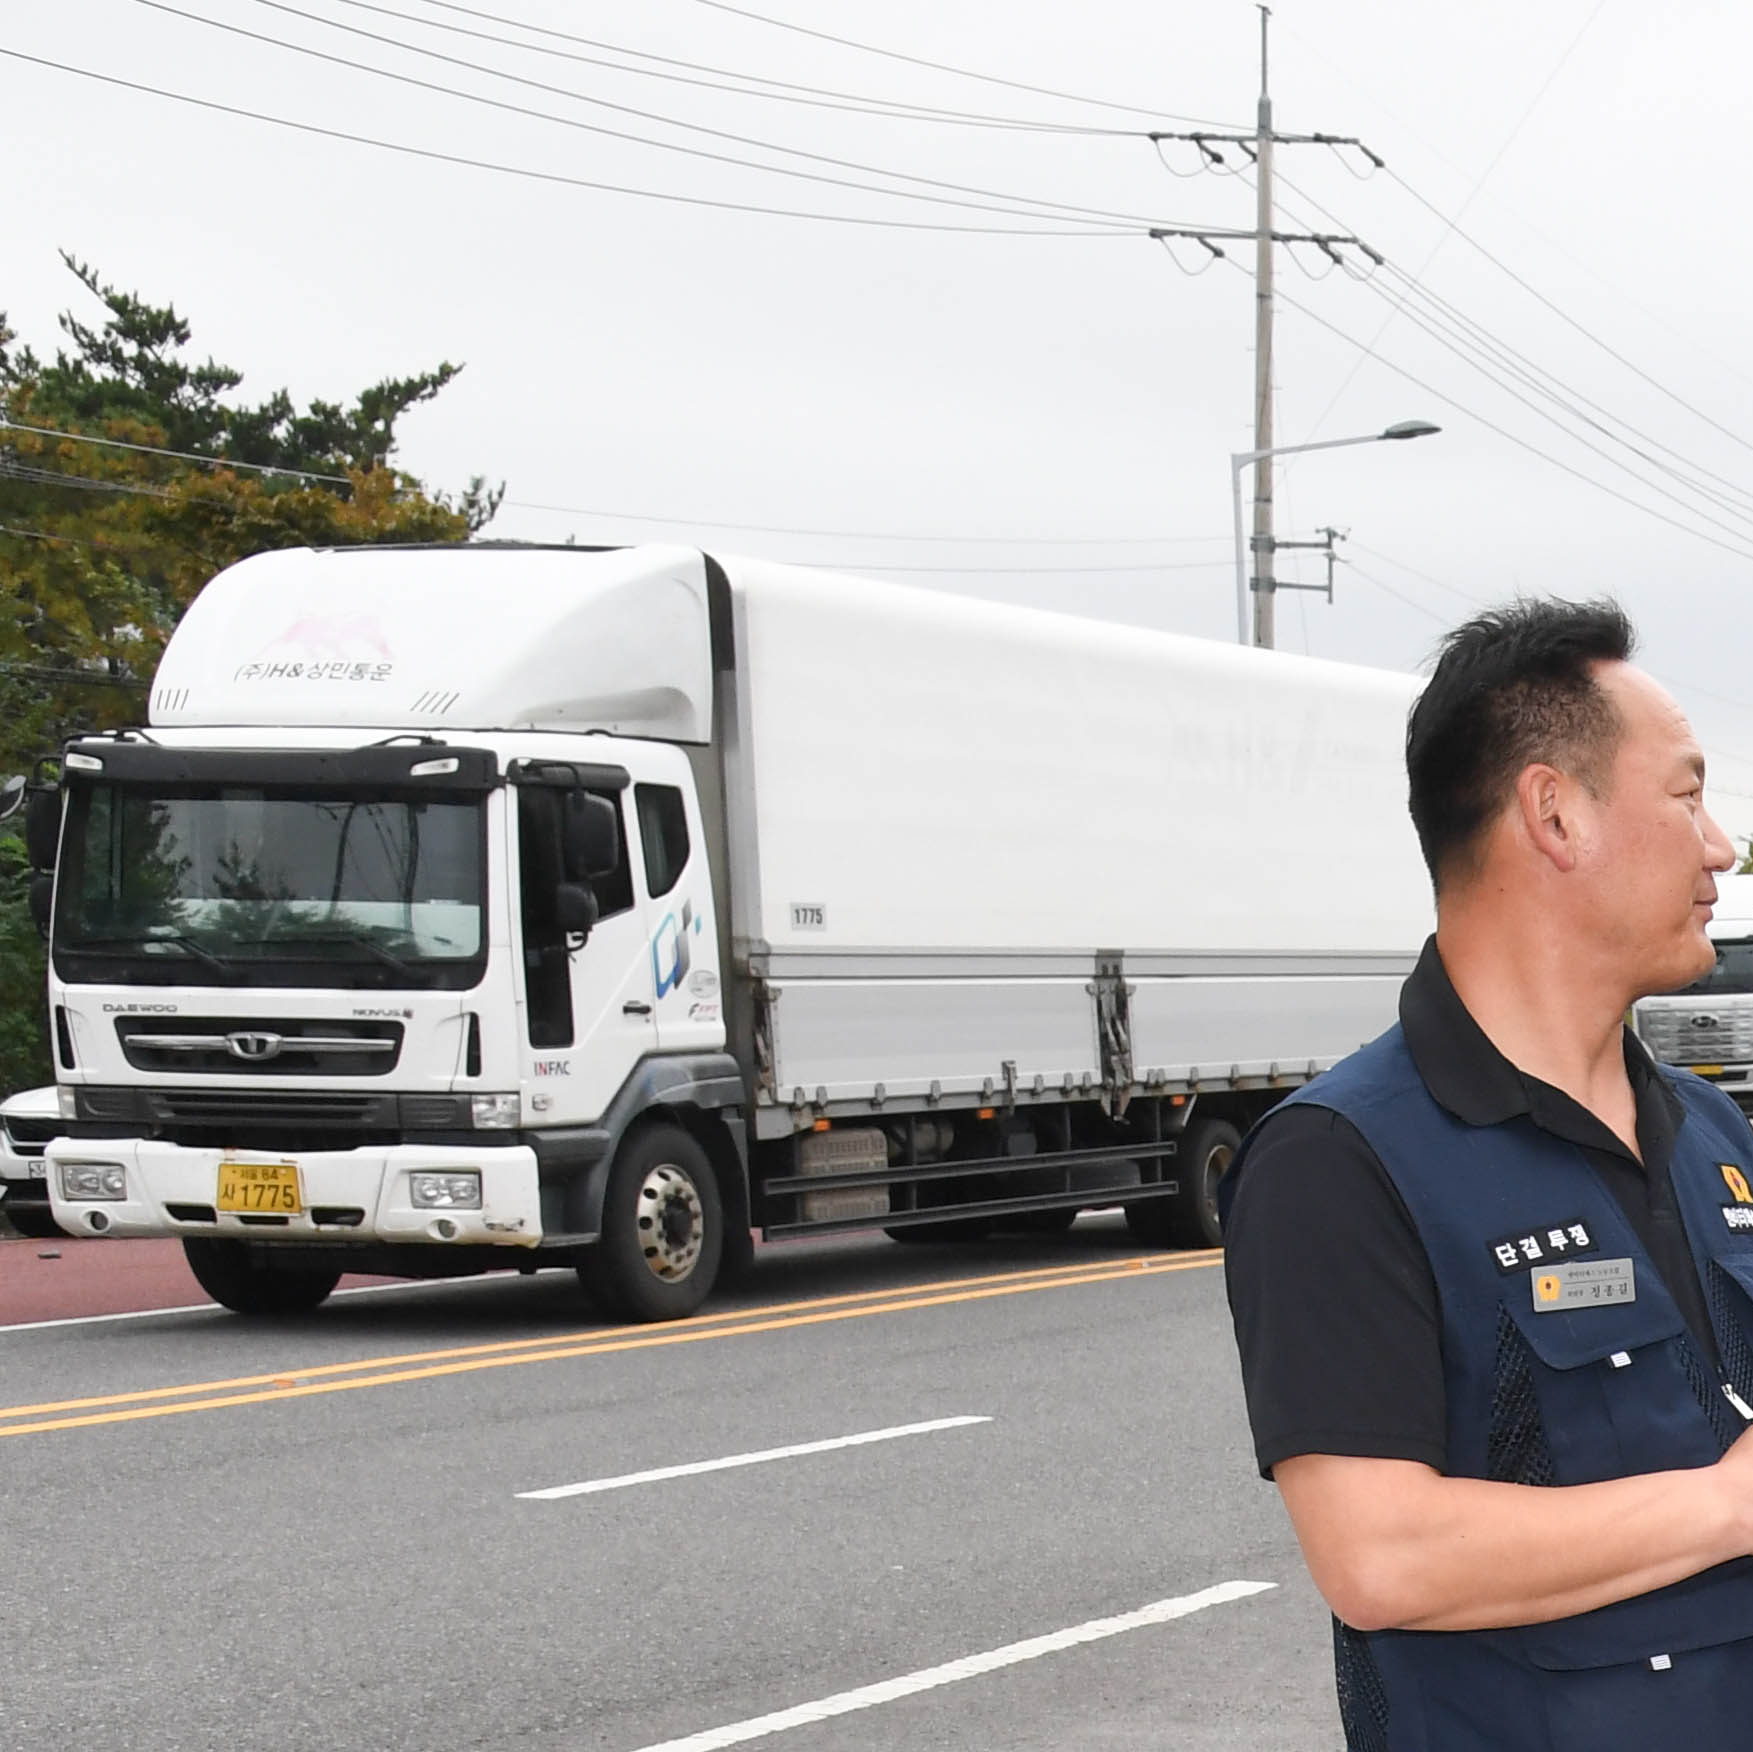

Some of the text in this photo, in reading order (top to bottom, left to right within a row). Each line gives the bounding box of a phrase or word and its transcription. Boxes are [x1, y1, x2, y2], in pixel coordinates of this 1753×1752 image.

[795, 907, 823, 924] 1775
[102, 1003, 178, 1013] DAEWOO
[534, 1060, 571, 1077] INFAC
[222, 1183, 295, 1209] 사 1775
[1495, 1223, 1590, 1268] 단결 투쟁
